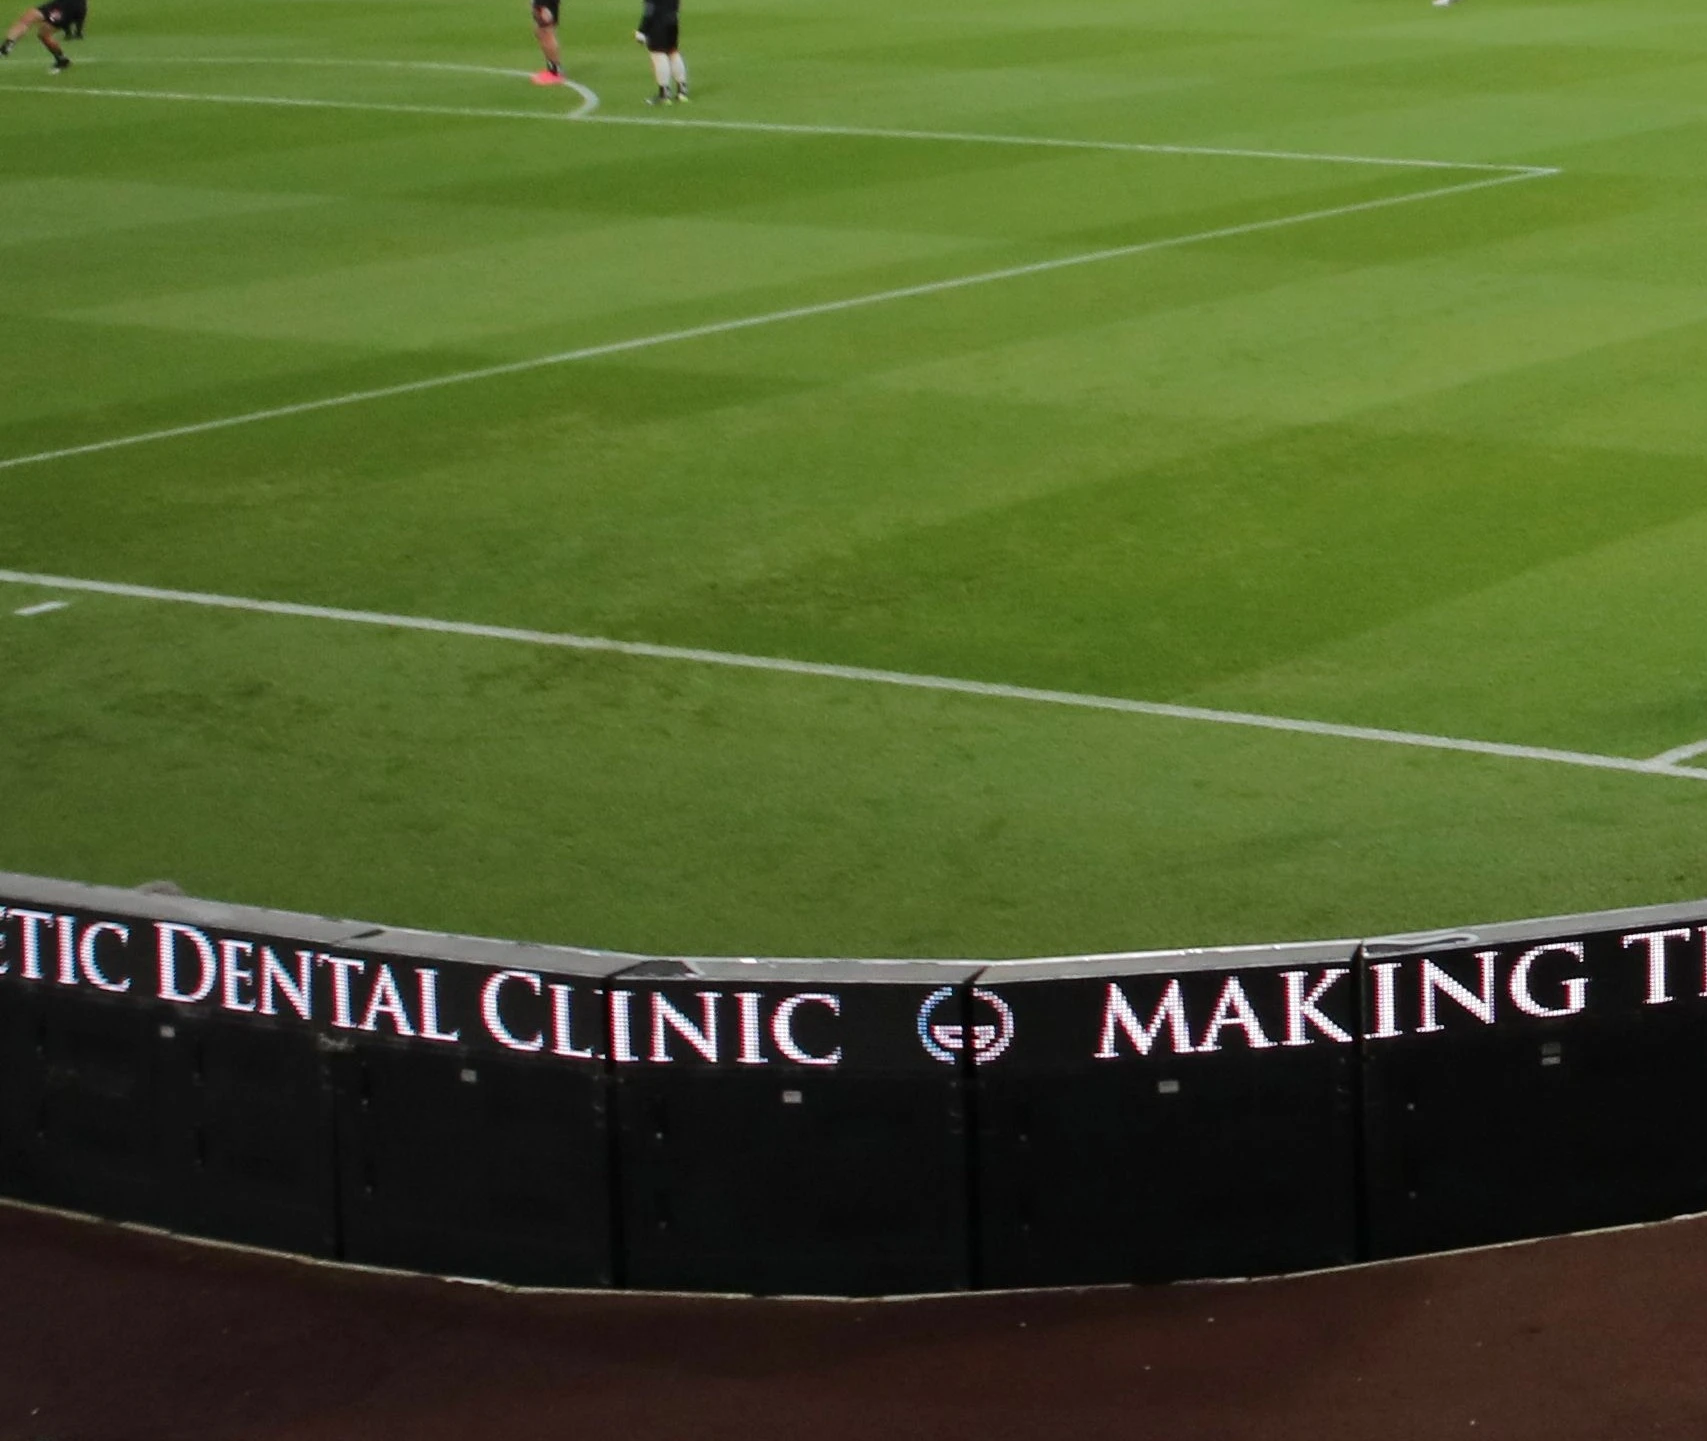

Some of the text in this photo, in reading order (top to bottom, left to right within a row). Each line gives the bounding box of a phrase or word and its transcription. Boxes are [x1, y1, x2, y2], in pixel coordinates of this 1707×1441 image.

[154, 921, 460, 1043] DENTAL
[480, 970, 843, 1065] CLINIC
[1092, 941, 1592, 1059] MAKING
